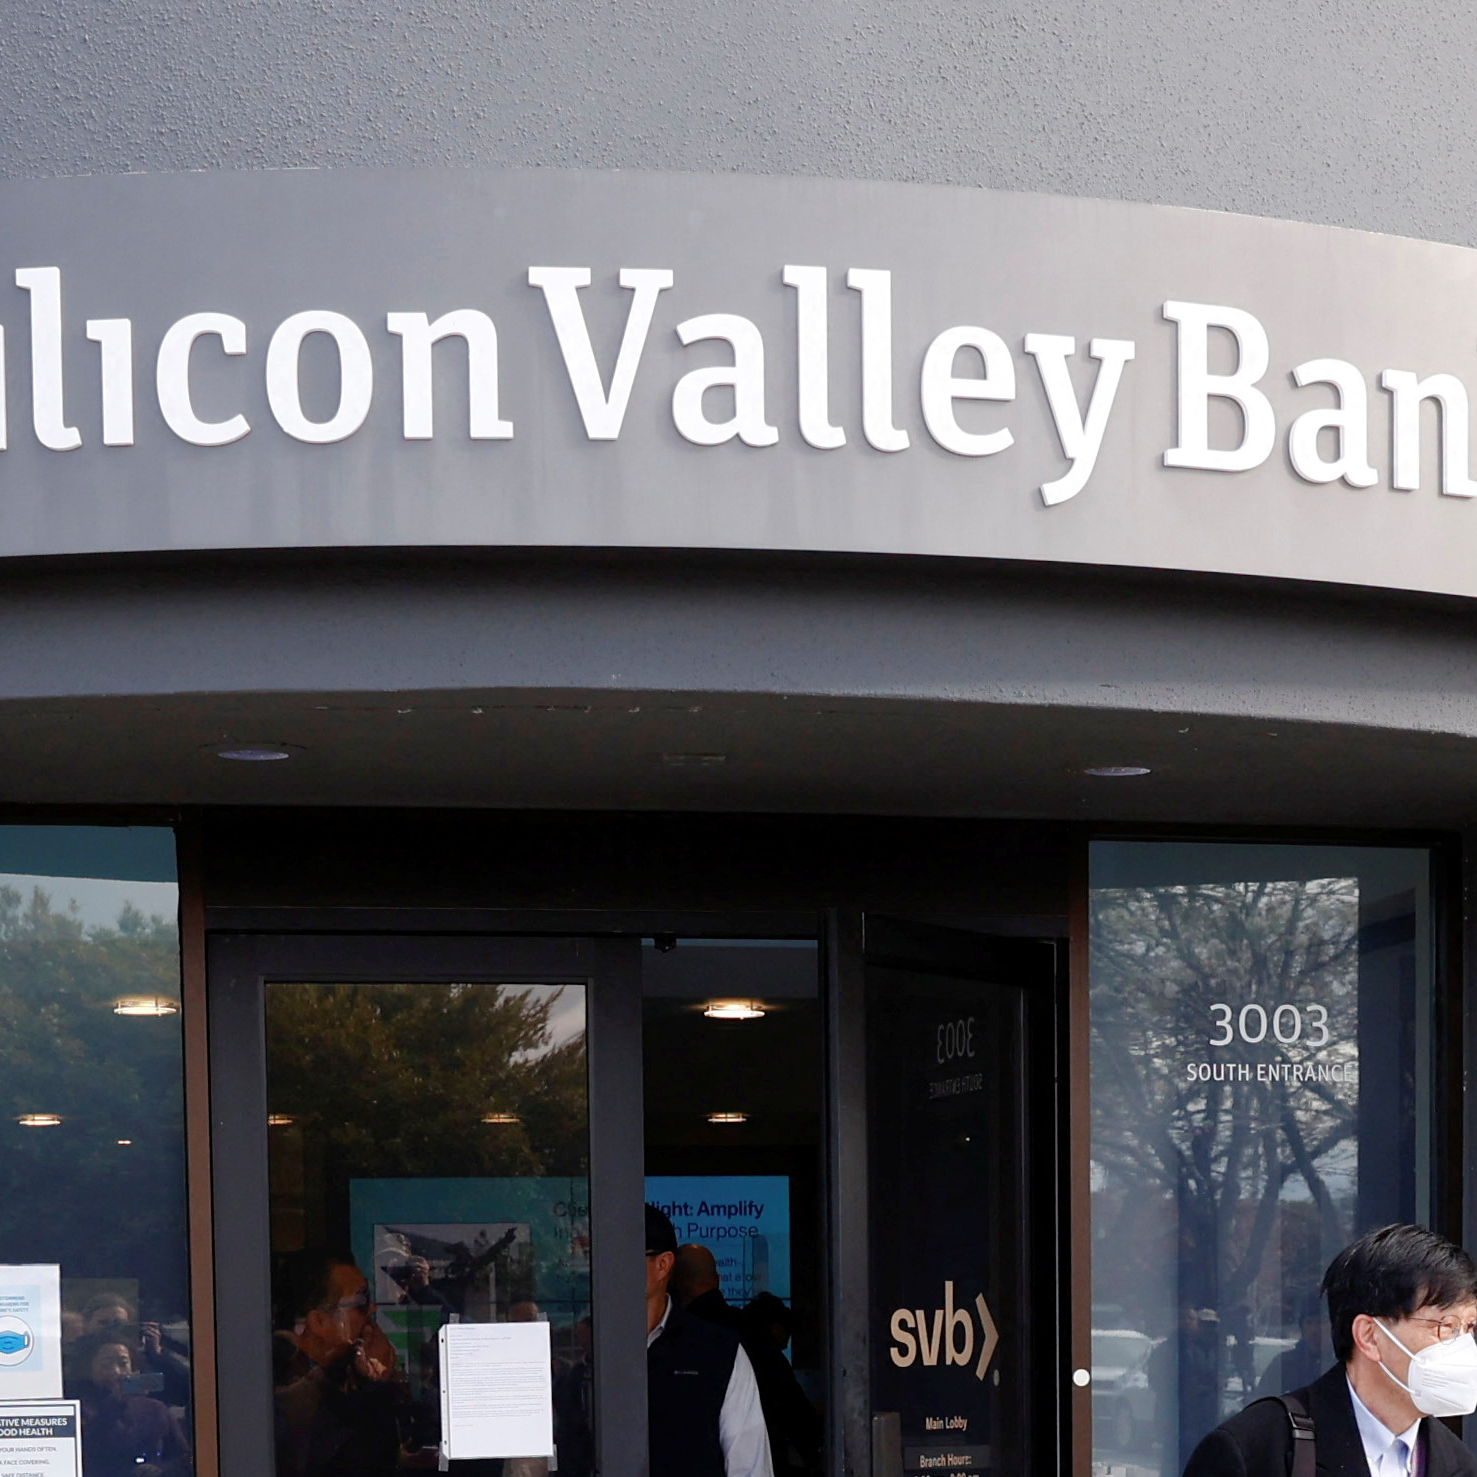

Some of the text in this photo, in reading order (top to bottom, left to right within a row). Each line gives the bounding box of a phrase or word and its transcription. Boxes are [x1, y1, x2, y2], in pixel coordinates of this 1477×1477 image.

[528, 266, 1135, 507] Valley
[1209, 1003, 1330, 1047] 3003
[1186, 1063, 1353, 1082] SOUTH ENTRANCE
[697, 1200, 765, 1220] Amplify
[687, 1222, 759, 1242] Purpose
[889, 1280, 974, 1368] svb
[21, 1418, 67, 1426] MEASURES
[925, 1415, 968, 1432] Main Lobby
[19, 1428, 53, 1436] HEALTH
[919, 1454, 946, 1468] Branch
